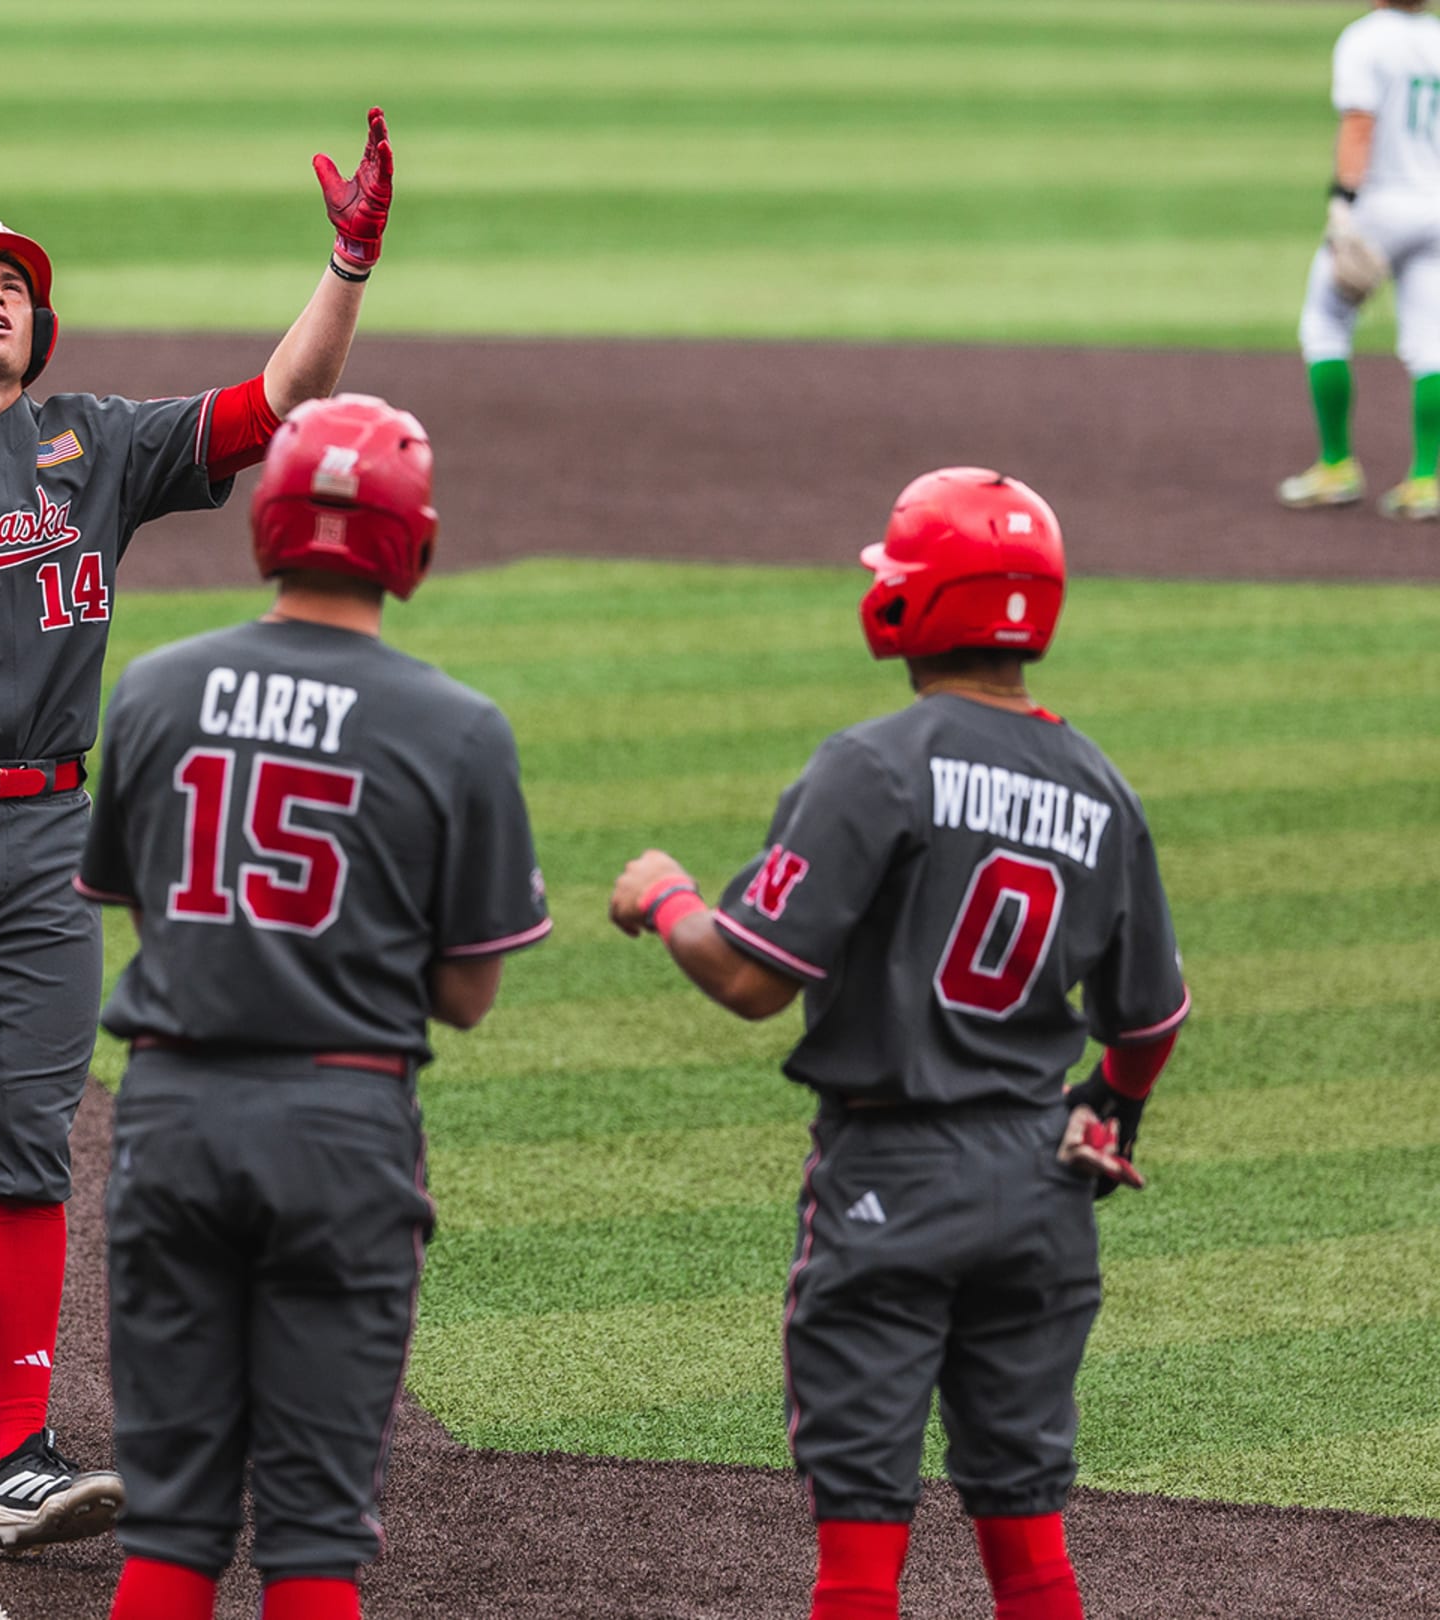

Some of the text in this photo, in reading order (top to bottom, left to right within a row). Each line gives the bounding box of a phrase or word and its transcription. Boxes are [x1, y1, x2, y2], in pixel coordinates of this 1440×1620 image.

[36, 550, 110, 632] 14
[199, 666, 359, 754] CAREY
[166, 747, 364, 937] 15
[930, 756, 1113, 870] WORTHLEY
[741, 842, 810, 921] N
[933, 846, 1065, 1021] 0
